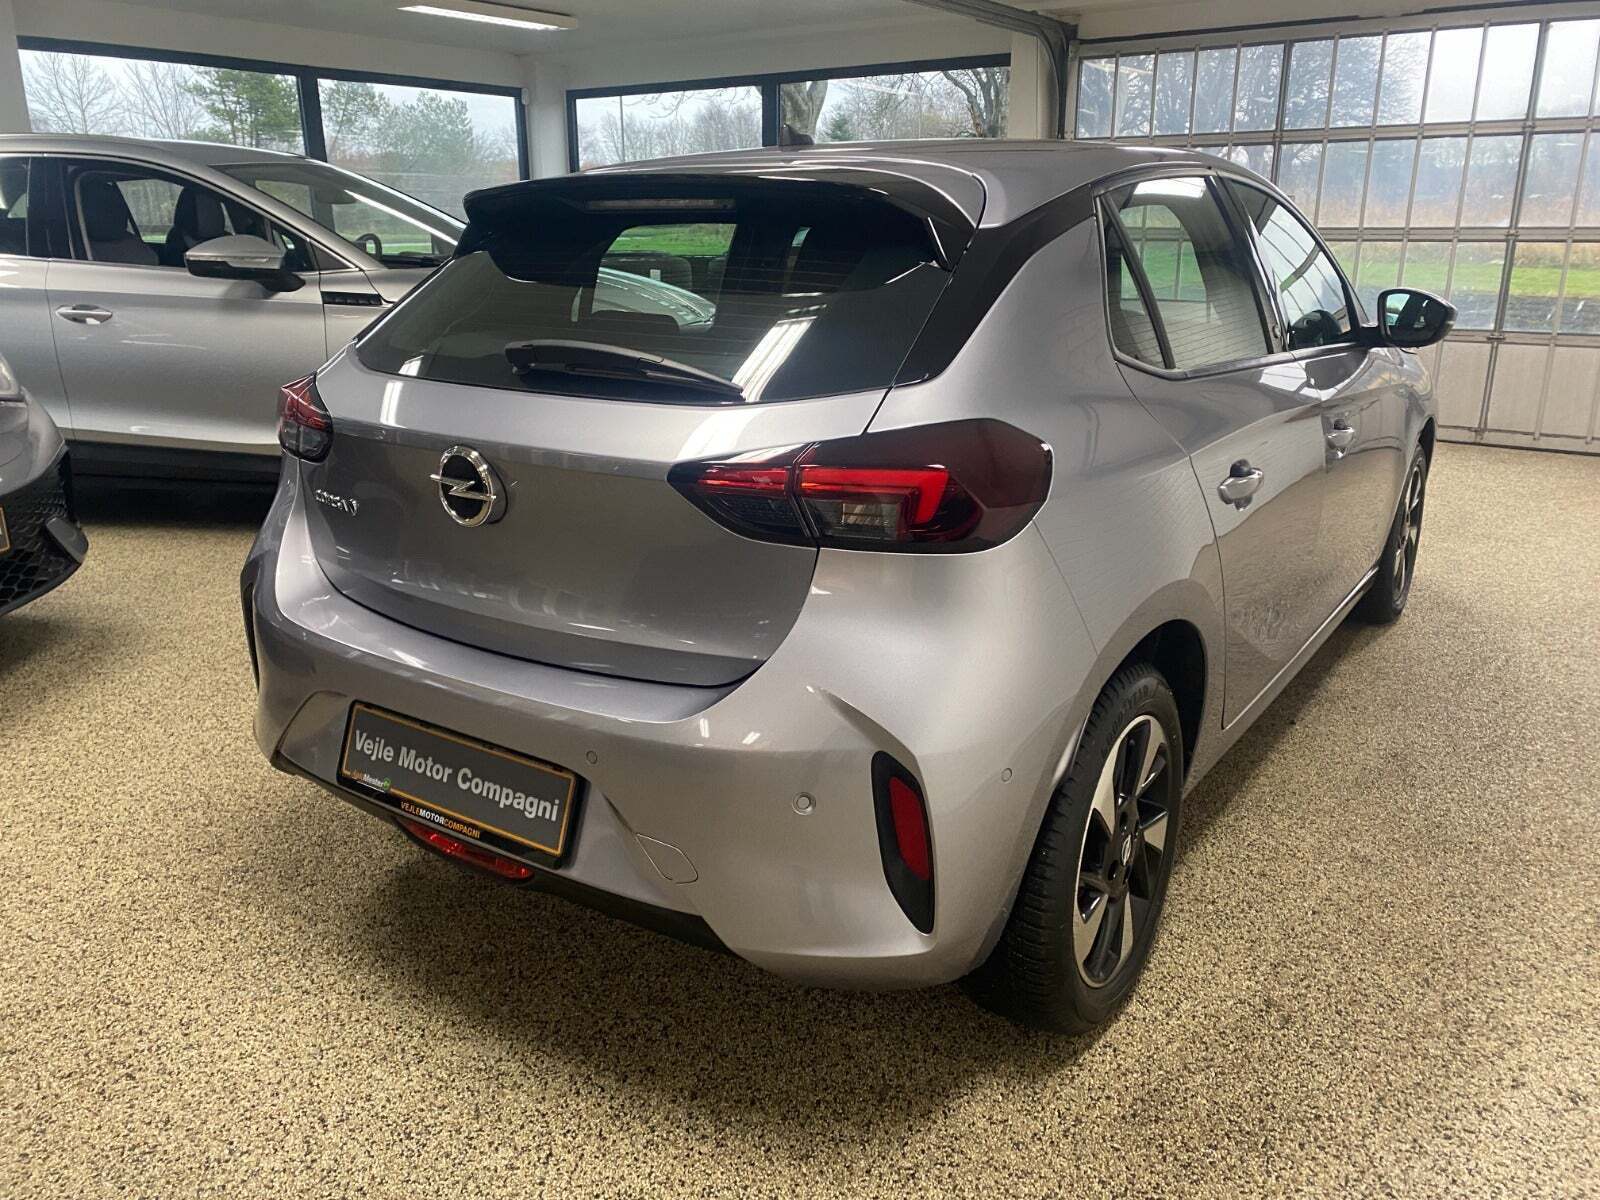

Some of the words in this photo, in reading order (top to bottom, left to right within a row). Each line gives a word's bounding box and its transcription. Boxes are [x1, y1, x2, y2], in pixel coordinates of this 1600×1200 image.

[355, 730, 393, 762] Vejle
[398, 746, 452, 783] Motor
[457, 767, 560, 822] Compagni
